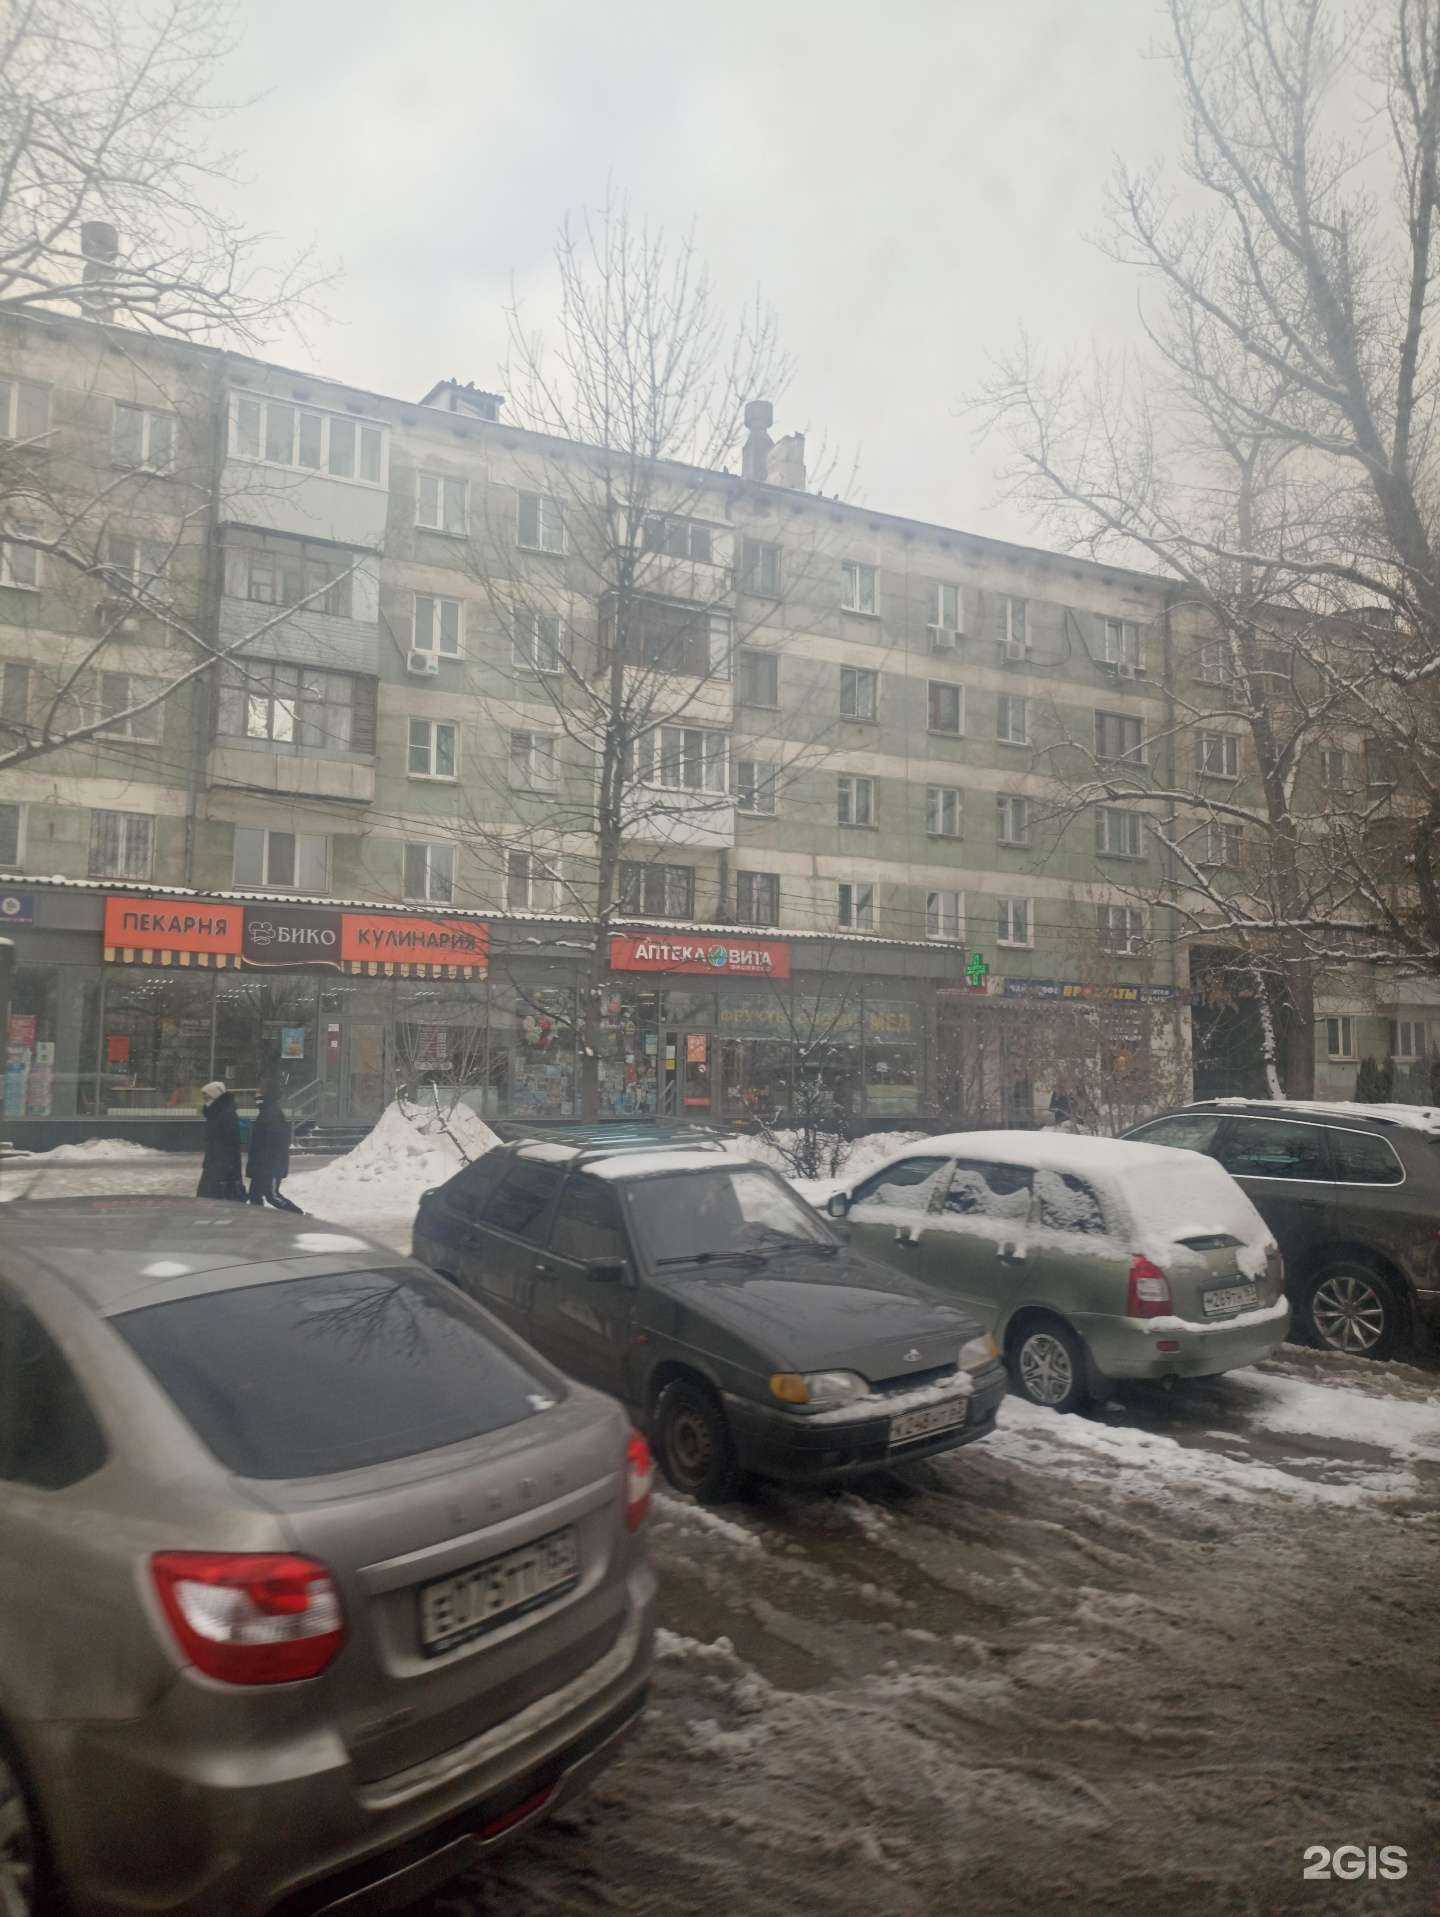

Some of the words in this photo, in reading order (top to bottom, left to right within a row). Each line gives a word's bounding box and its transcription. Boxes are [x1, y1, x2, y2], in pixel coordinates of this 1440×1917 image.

[123, 911, 228, 936] ПЕКАРНЯ
[277, 926, 336, 945] БИКО
[358, 928, 477, 950] КУЛИНАРИЯ
[635, 944, 707, 962] АПТЕКА
[729, 949, 772, 966] ВИТА
